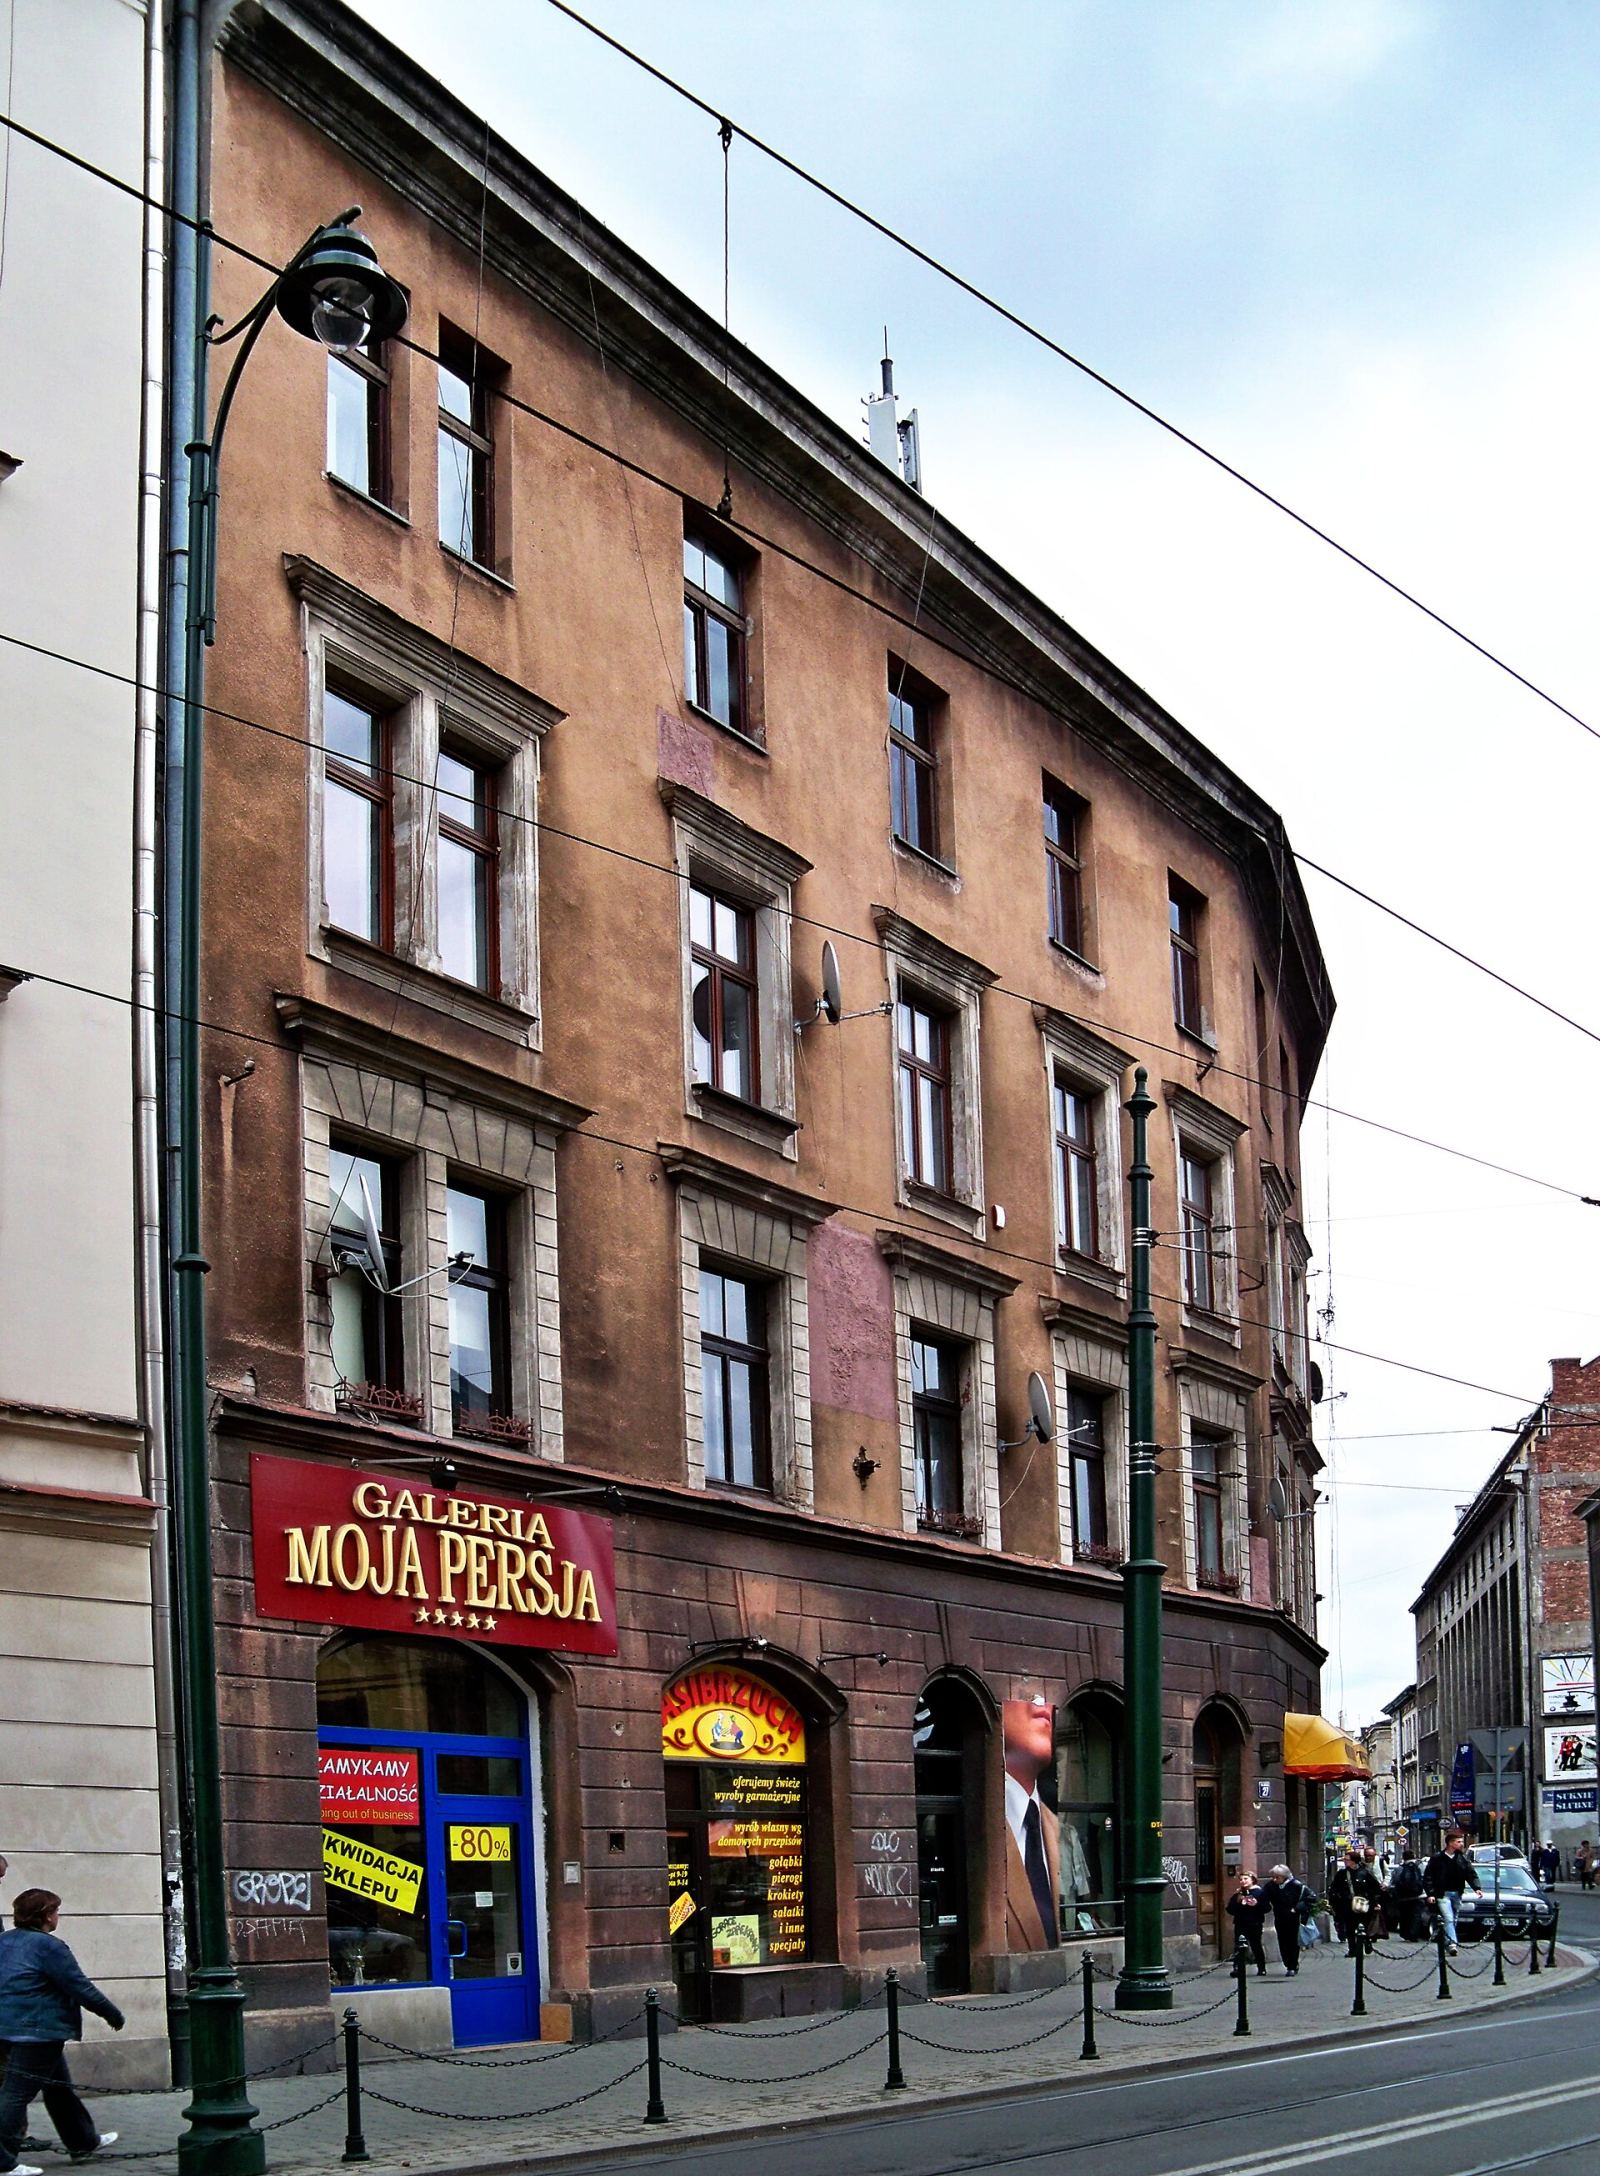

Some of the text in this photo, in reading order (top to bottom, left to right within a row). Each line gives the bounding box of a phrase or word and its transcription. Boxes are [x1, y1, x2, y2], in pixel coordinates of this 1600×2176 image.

[352, 1482, 555, 1549] GALERIA
[284, 1523, 603, 1622] MOJA PERSJA
[733, 1775, 801, 1790] oferujemy świeże
[714, 1790, 801, 1804] wyroby garmażeryjne
[1556, 1791, 1594, 1800] SUKNIE
[342, 1809, 358, 1819] out
[360, 1808, 370, 1819] of
[372, 1809, 415, 1820] business
[734, 1821, 802, 1835] wyrób własny wg
[452, 1828, 509, 1858] -80%
[717, 1834, 802, 1849] domowych przepisów
[768, 1855, 803, 1870] gołąbki
[323, 1861, 399, 1903] SKLEPU
[771, 1871, 803, 1886] pierogi
[767, 1888, 804, 1903] krokiety
[772, 1905, 805, 1919] sałatki
[785, 1922, 805, 1934] inne
[769, 1938, 806, 1954] specjały
